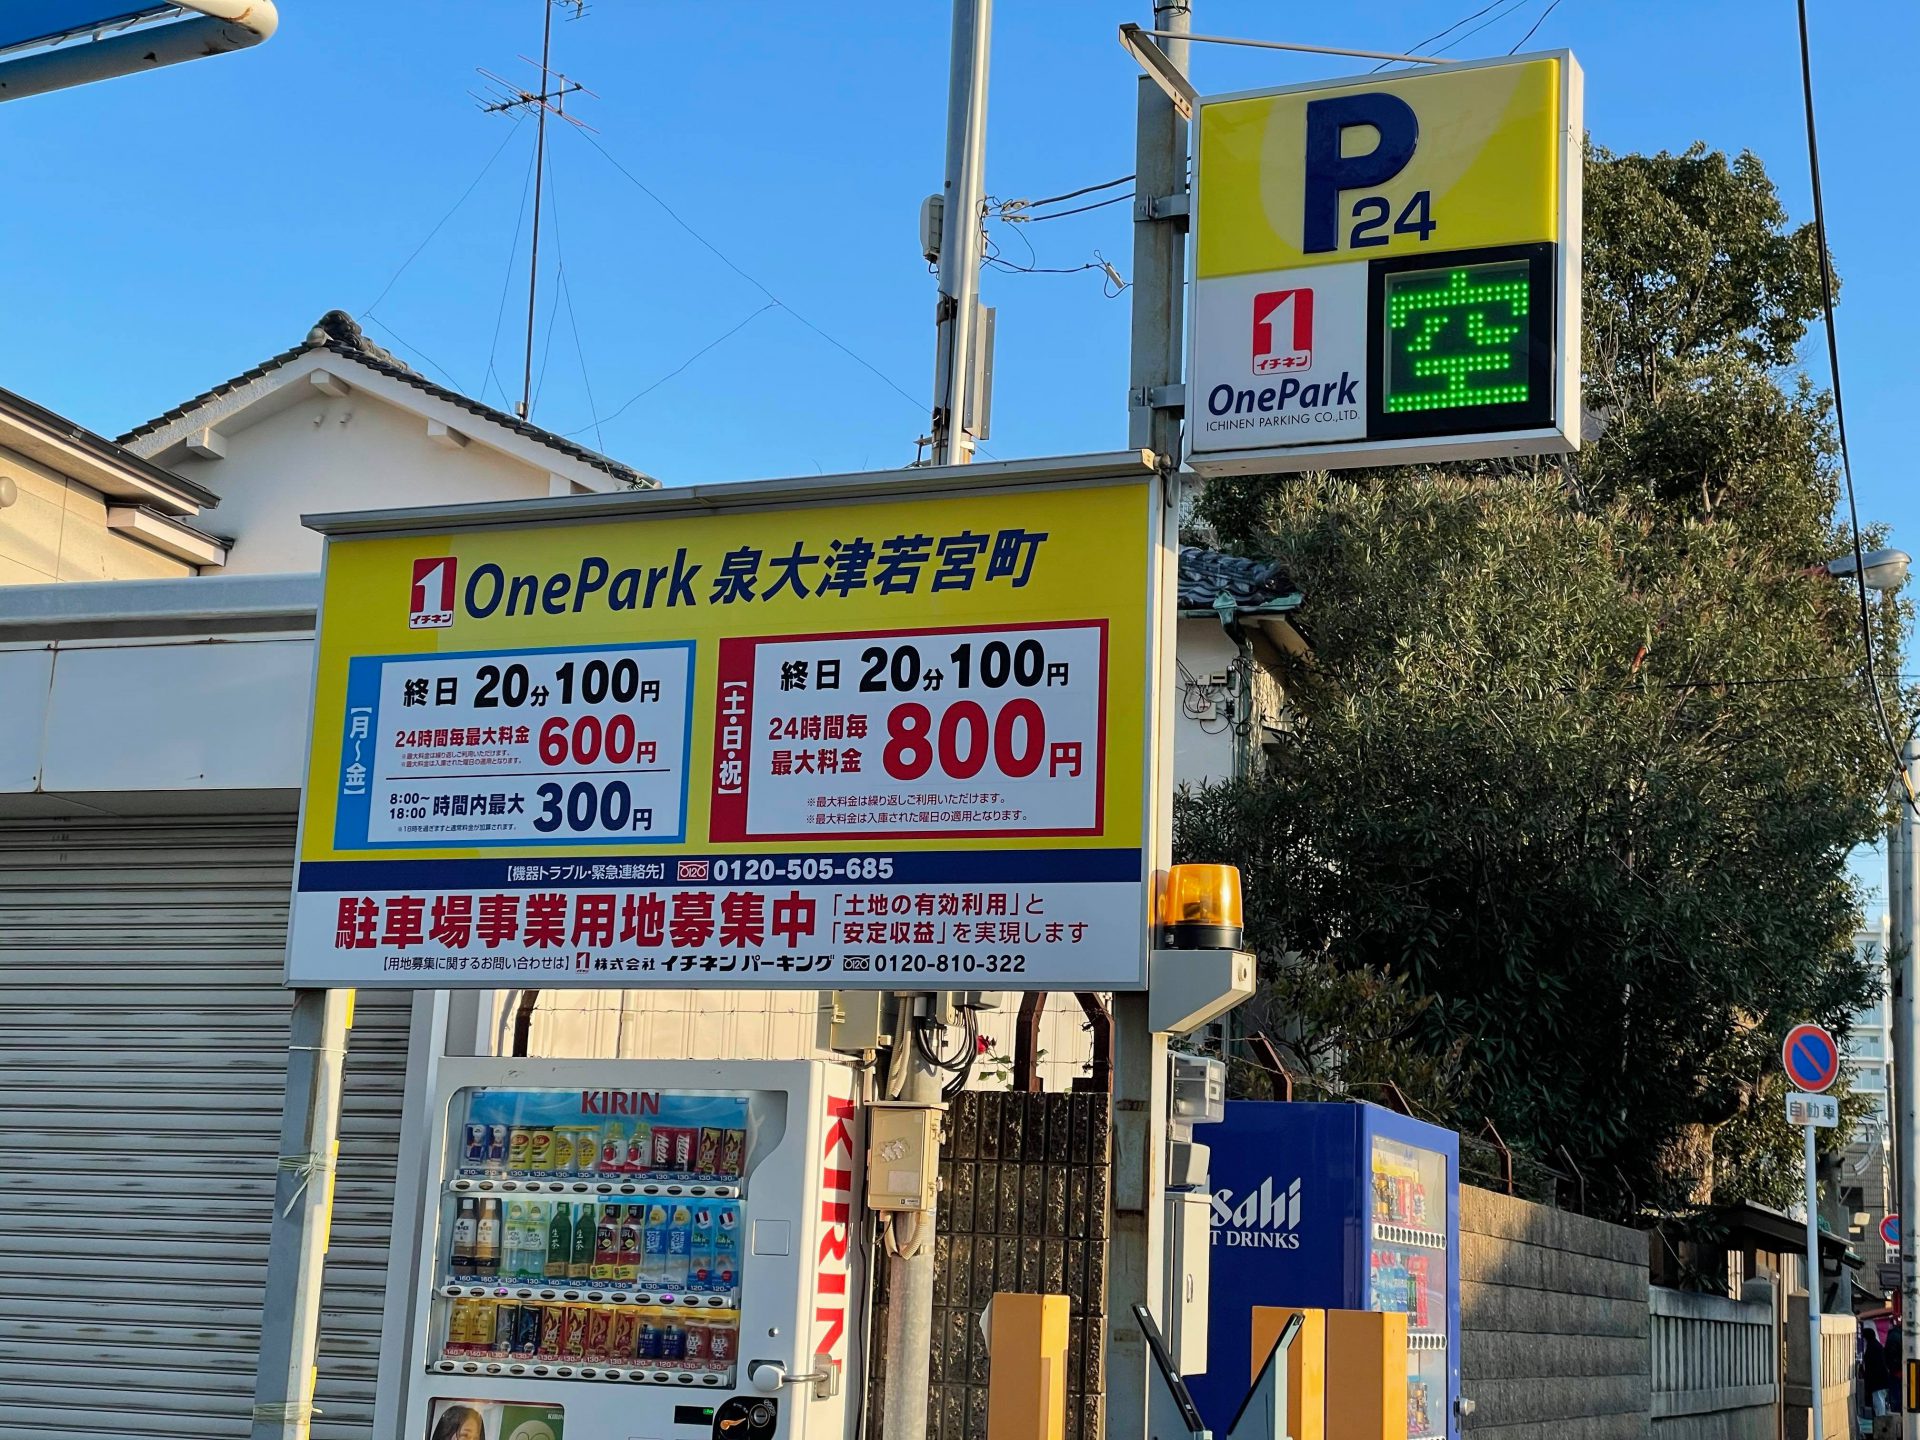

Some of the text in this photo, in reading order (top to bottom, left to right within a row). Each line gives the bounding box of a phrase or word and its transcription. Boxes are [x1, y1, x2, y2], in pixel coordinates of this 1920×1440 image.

[1303, 92, 1419, 254] P
[1349, 191, 1436, 249] 24
[1389, 272, 1529, 413] 空
[1256, 355, 1309, 370] イチネン
[1208, 371, 1360, 416] OnePark
[1206, 418, 1255, 432] ICHINEN
[1259, 413, 1310, 428] PARKING
[464, 528, 1049, 619] OnePark 泉大津若宮町
[410, 613, 452, 625] イチネン
[780, 658, 841, 692] 終日
[402, 677, 459, 708] 終日
[394, 713, 658, 767] 24時間毎最大料金 600円
[768, 712, 869, 741] 24時間毎
[770, 697, 1083, 781] 最大料金 800円
[389, 807, 427, 819] 18:00
[432, 781, 654, 833] 時間内最大 300円
[713, 857, 895, 882] 0120-505-685
[335, 890, 818, 951] 駐車場事業用地募集中
[832, 892, 1045, 919] 「土地の有効利用」と
[831, 920, 1089, 946] 「安定収益」を実現します
[874, 954, 1027, 973] 0120-810-322
[581, 1090, 661, 1116] KIRIN
[1789, 1100, 1836, 1120] 自動車
[1210, 1176, 1301, 1231] sahi
[815, 1094, 855, 1374] KIRIN
[1226, 1231, 1300, 1249] DRINKS
